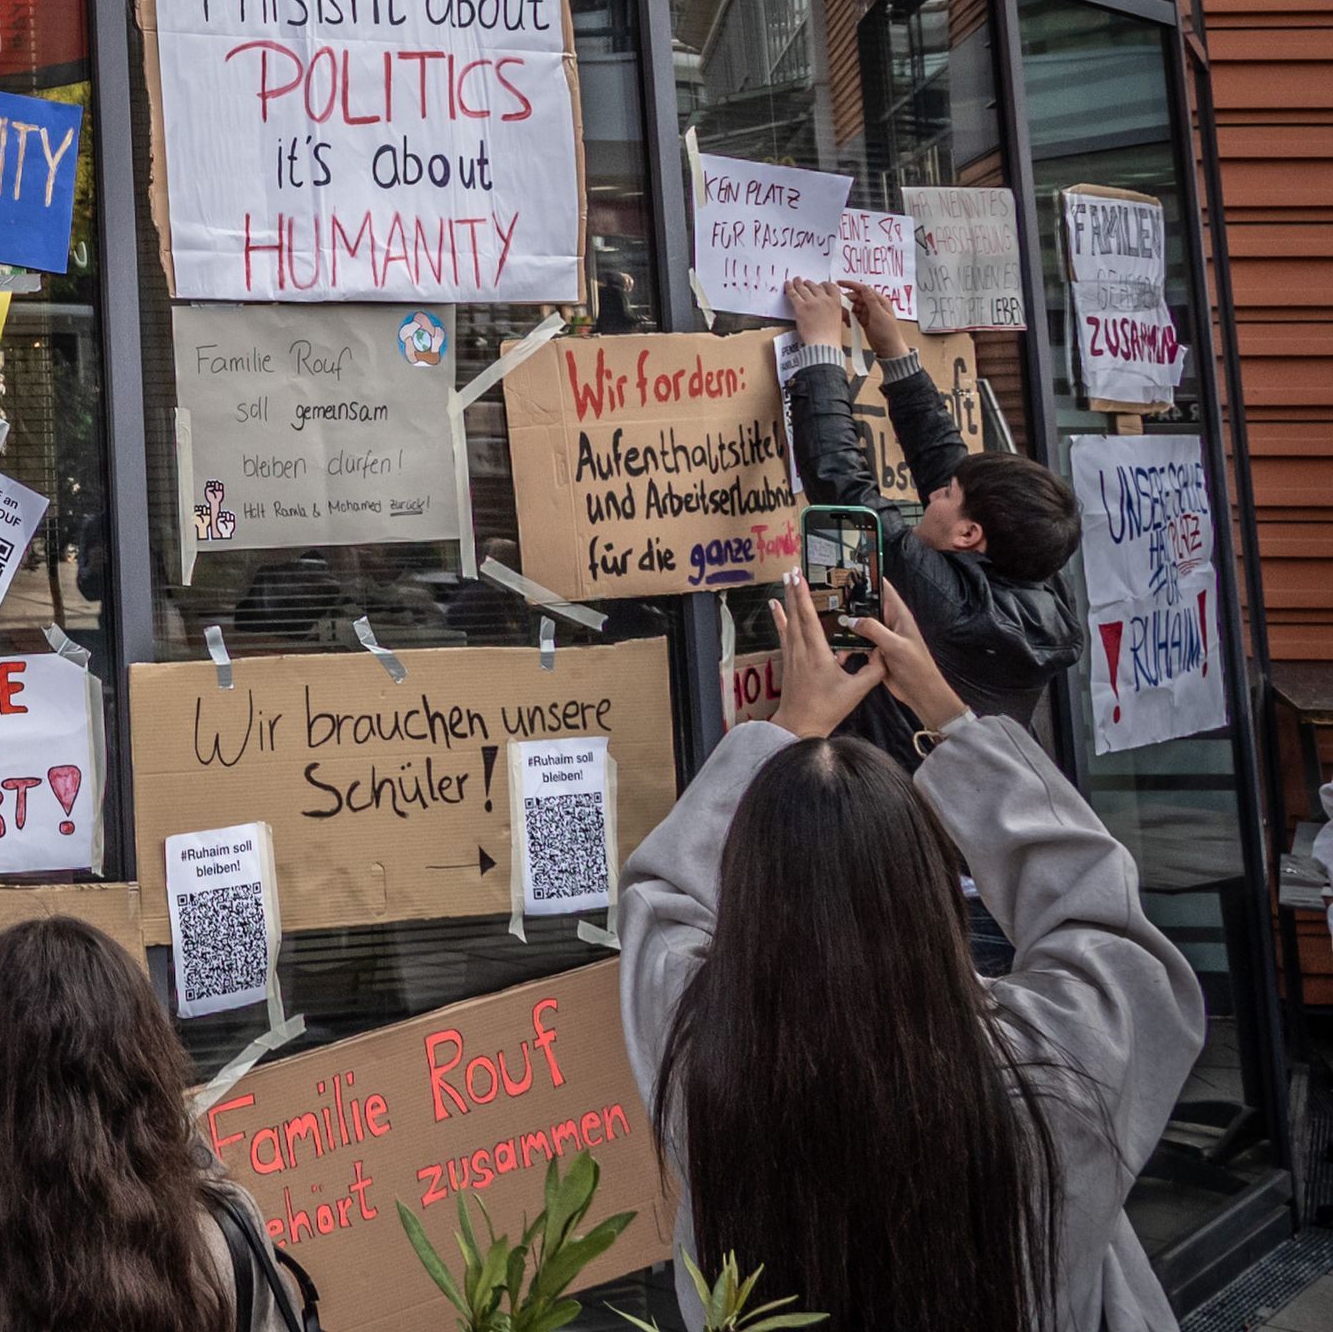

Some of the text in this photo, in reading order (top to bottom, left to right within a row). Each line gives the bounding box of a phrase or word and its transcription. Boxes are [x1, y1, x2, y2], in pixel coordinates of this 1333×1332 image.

[225, 39, 533, 125] POLITICS
[277, 134, 494, 192] it's about
[745, 178, 801, 210] PLATZ
[243, 209, 520, 293] HUMANITY
[711, 220, 744, 251] FÜR
[194, 339, 354, 382] Familie Rouf
[565, 347, 749, 422] Wir fordern:
[236, 396, 389, 432] soll gemeinsam
[242, 453, 308, 479] bleiben
[575, 420, 784, 483] Aufenthaltstitel
[3, 495, 19, 510] an
[585, 475, 796, 525] und Arbeitserlaubnis
[588, 535, 634, 582] für
[637, 536, 677, 572] die
[687, 536, 756, 586] ganze
[194, 685, 613, 767] Wir brauchen unsere
[301, 744, 500, 819] Schüler!
[527, 750, 595, 770] #Ruhaim soll
[541, 767, 584, 785] bleiben!
[180, 838, 253, 864] #Ruhaim soll
[195, 859, 242, 878] bleiben!
[206, 996, 569, 1176] Familie Rouf
[265, 1100, 633, 1250] ehört zusammen
